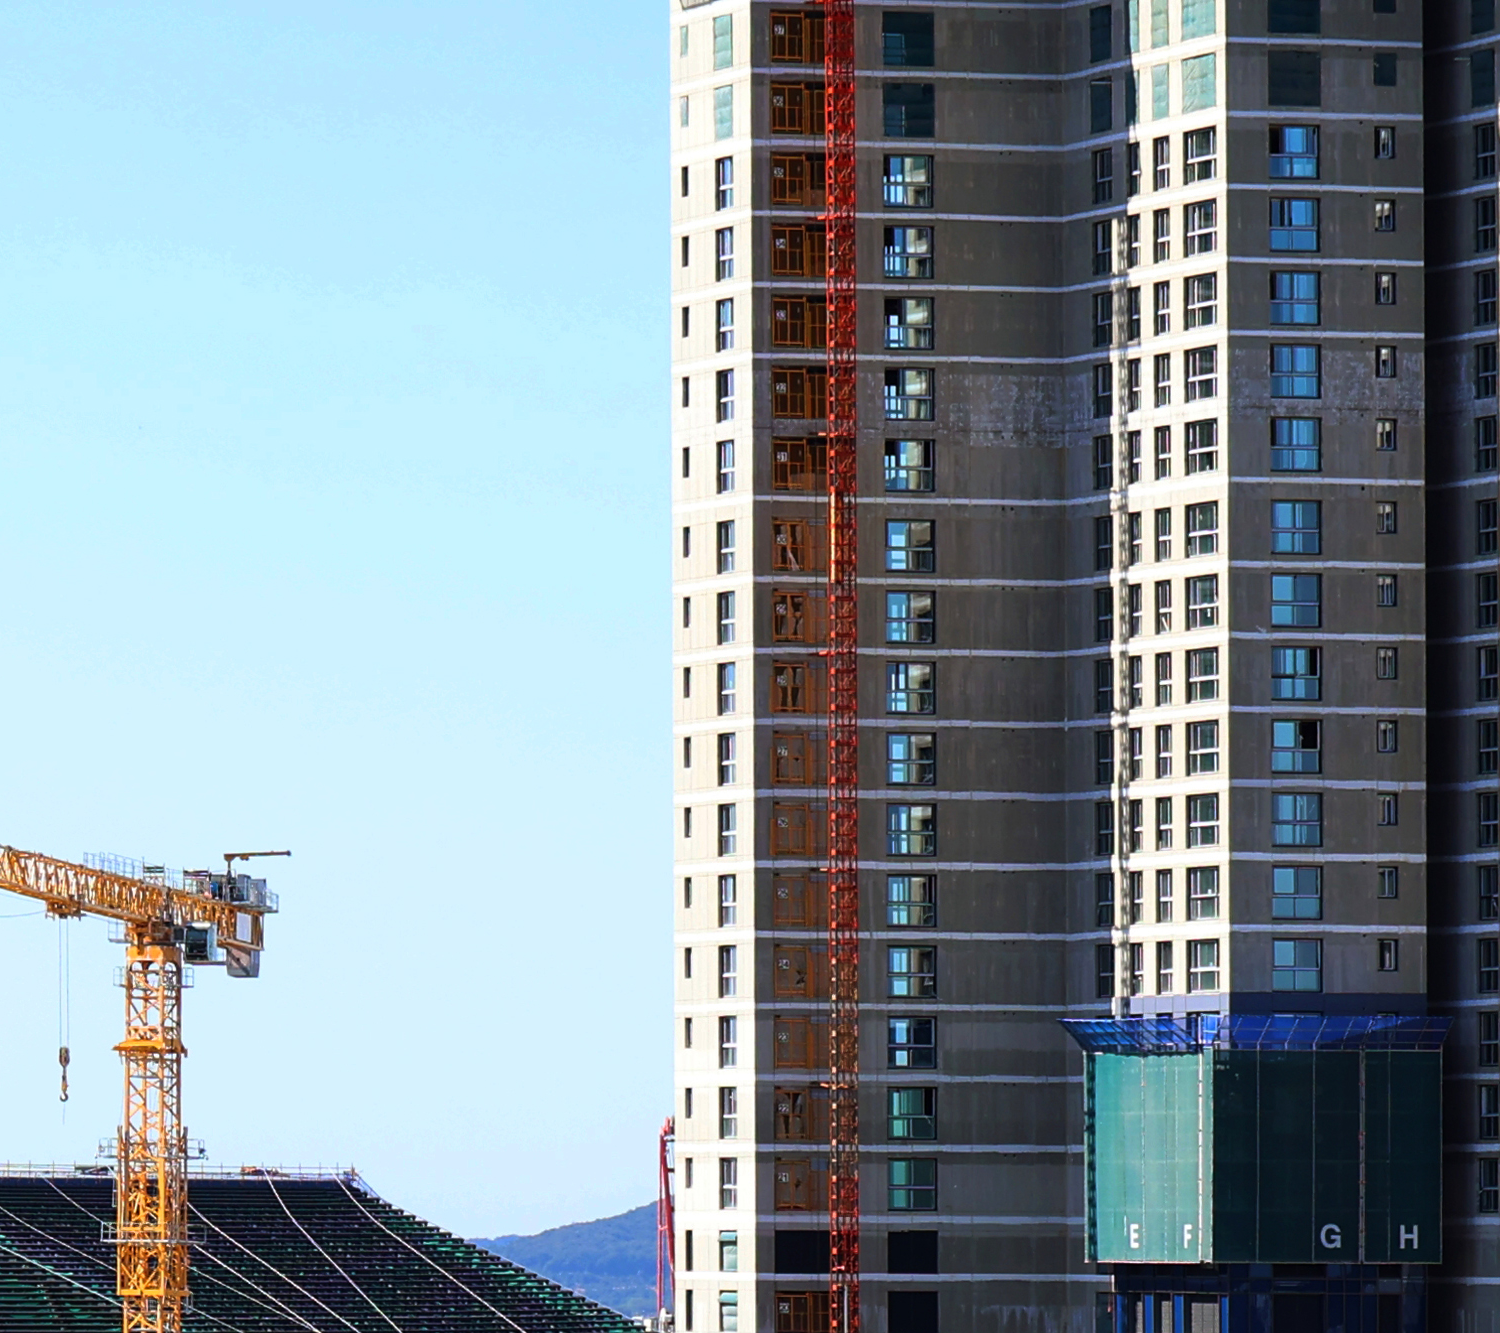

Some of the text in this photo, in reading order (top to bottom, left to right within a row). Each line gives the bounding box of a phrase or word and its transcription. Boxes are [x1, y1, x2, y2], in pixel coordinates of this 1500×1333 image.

[1130, 1224, 1192, 1248] E F
[1320, 1224, 1418, 1249] G H
